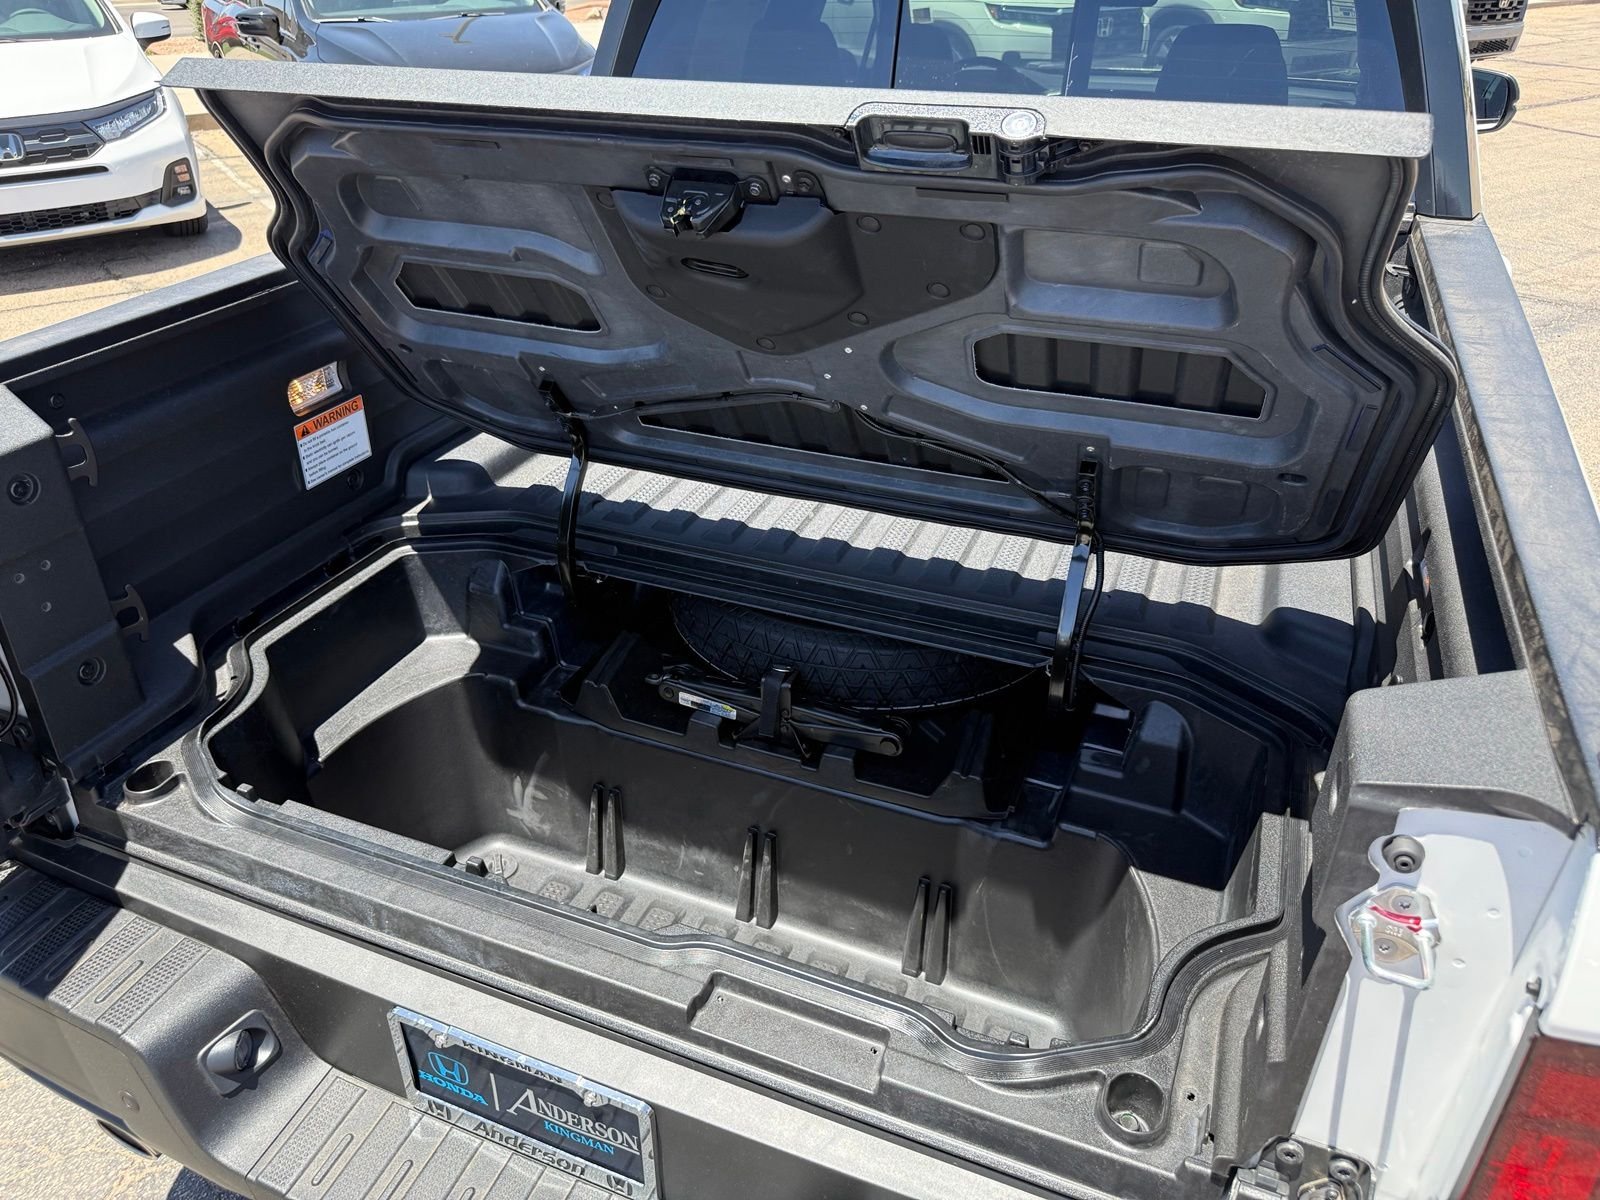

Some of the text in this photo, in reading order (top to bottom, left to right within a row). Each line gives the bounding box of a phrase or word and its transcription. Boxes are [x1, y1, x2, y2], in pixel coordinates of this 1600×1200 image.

[313, 400, 359, 429] WARNING
[462, 1040, 562, 1083] KINGMAN
[418, 1070, 489, 1105] HONDA
[507, 1088, 640, 1150] ANDERSON
[544, 1120, 615, 1155] KINGMAN
[473, 1121, 586, 1176] Anderson
